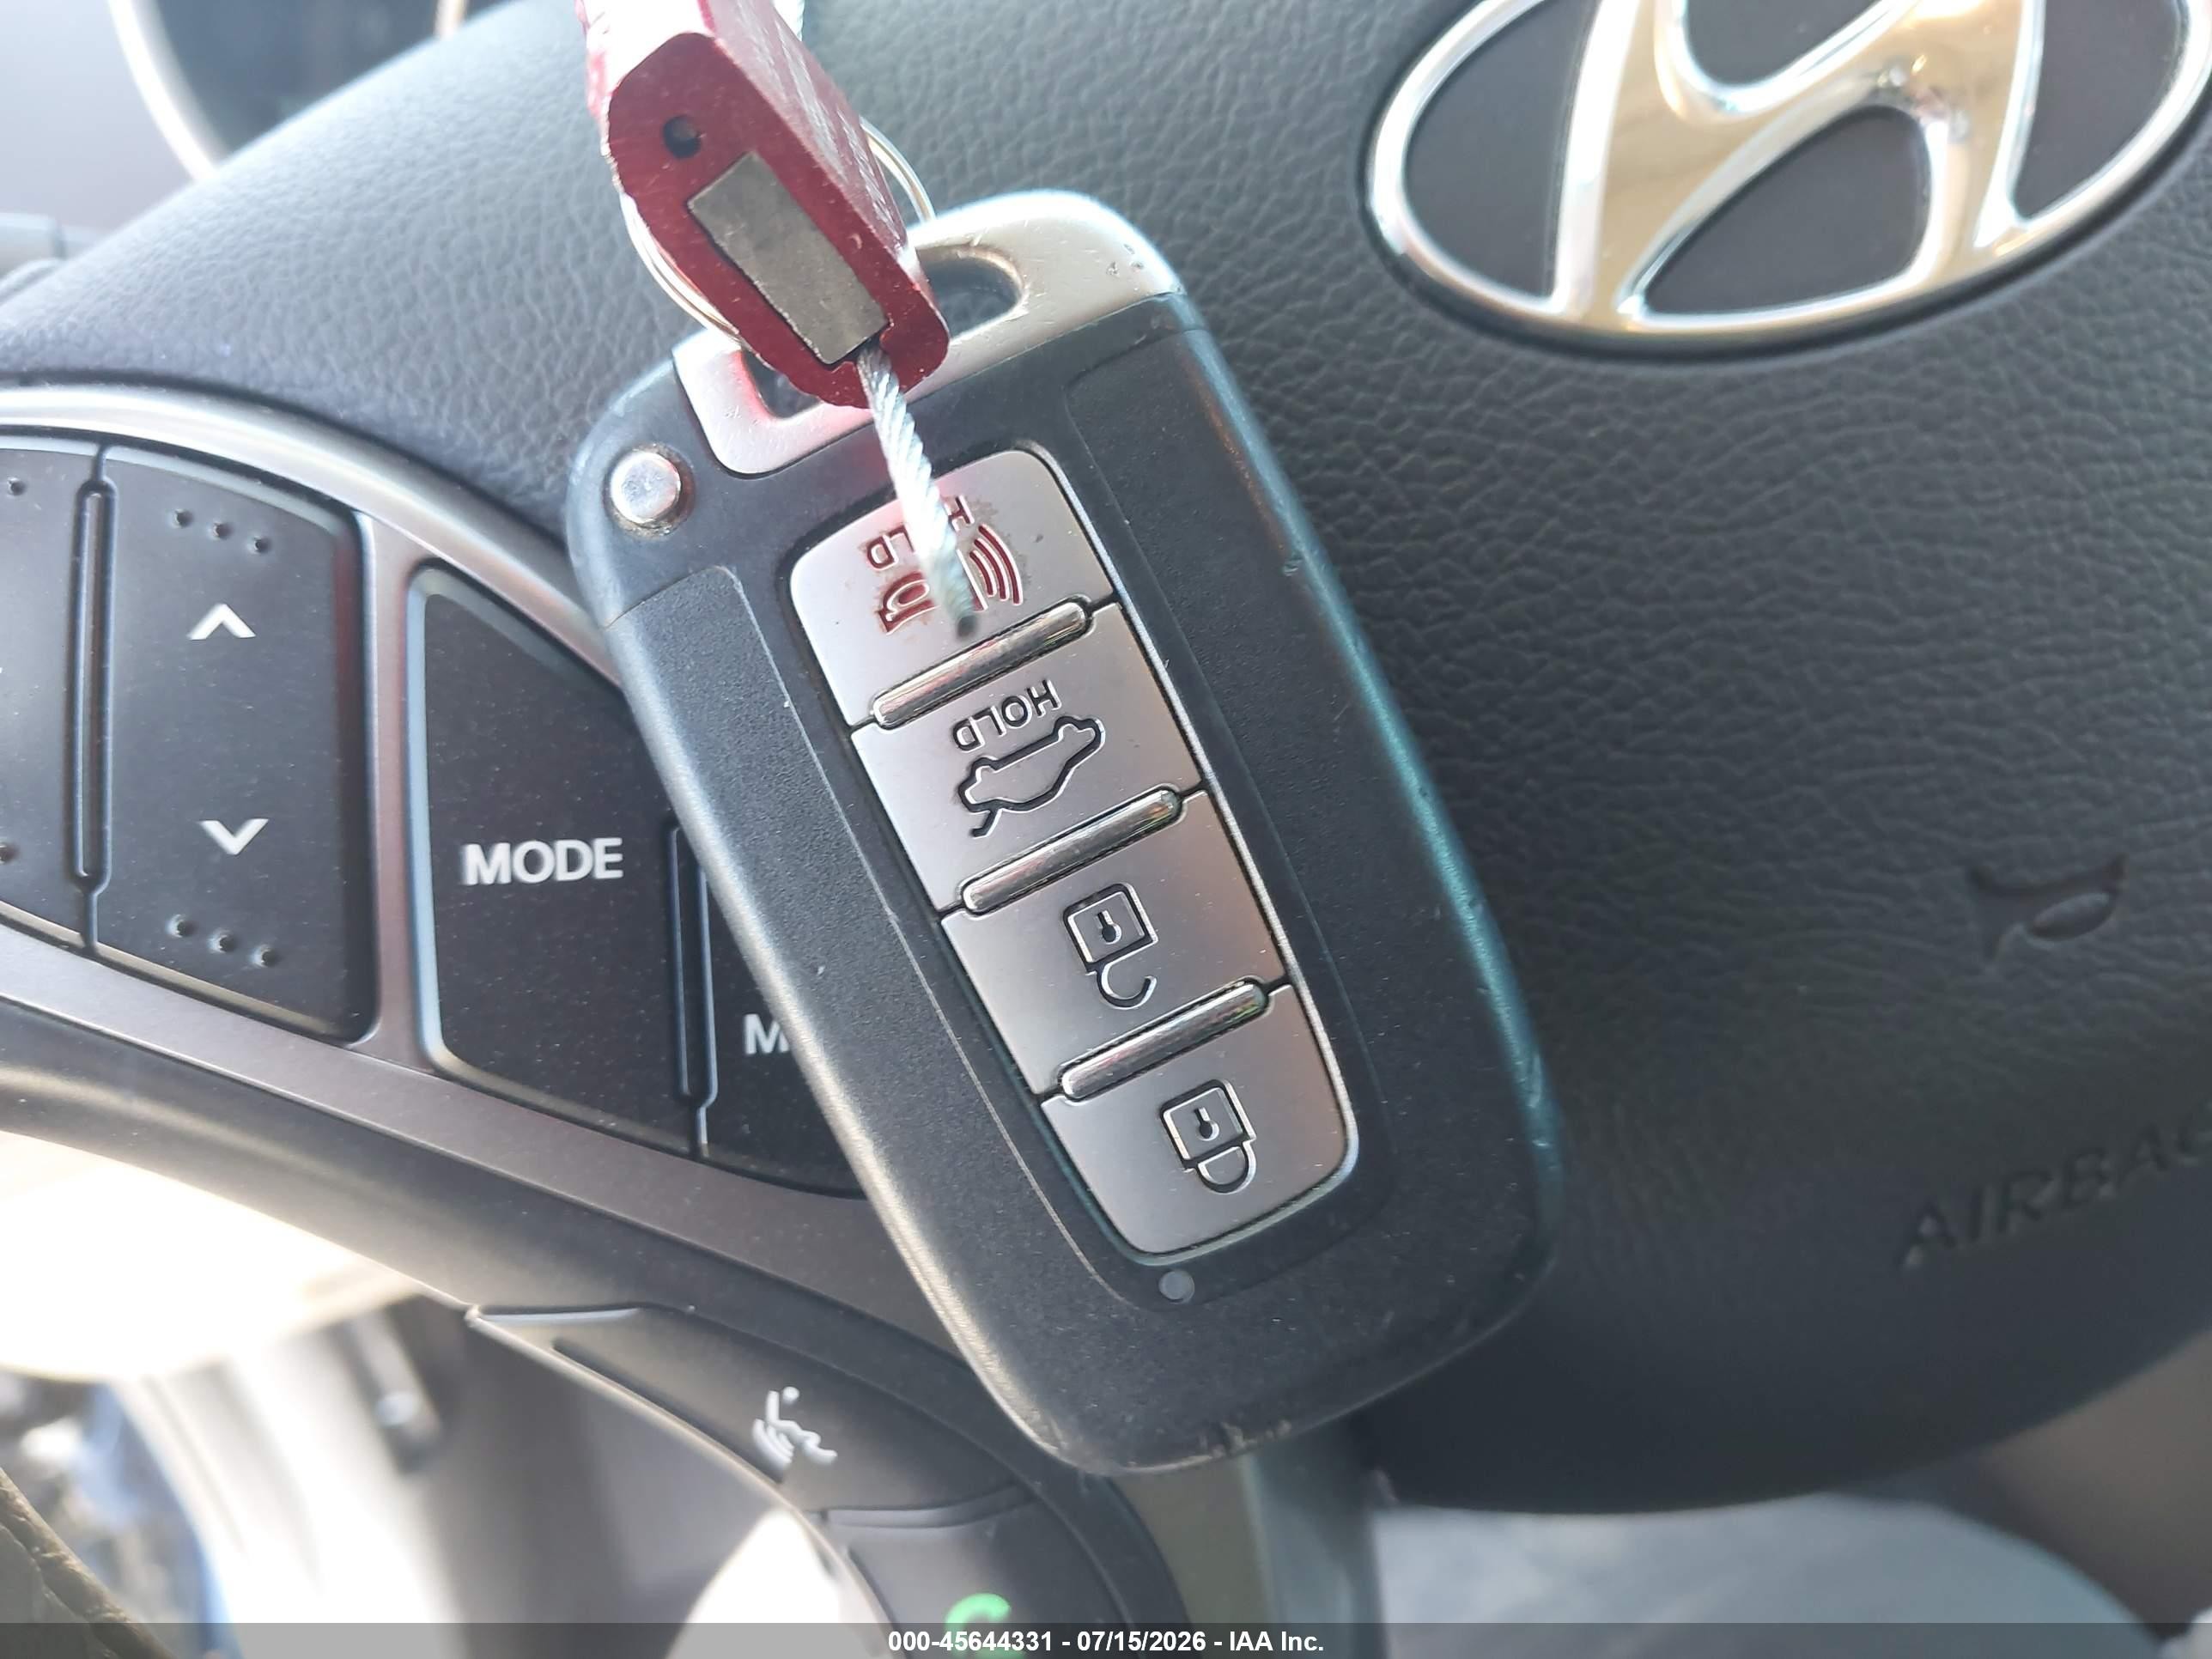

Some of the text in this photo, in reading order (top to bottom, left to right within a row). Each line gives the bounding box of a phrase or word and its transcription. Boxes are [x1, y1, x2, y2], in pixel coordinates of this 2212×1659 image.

[866, 495, 975, 571] HLD
[951, 678, 1062, 752] HOLD
[461, 836, 625, 886] MODE
